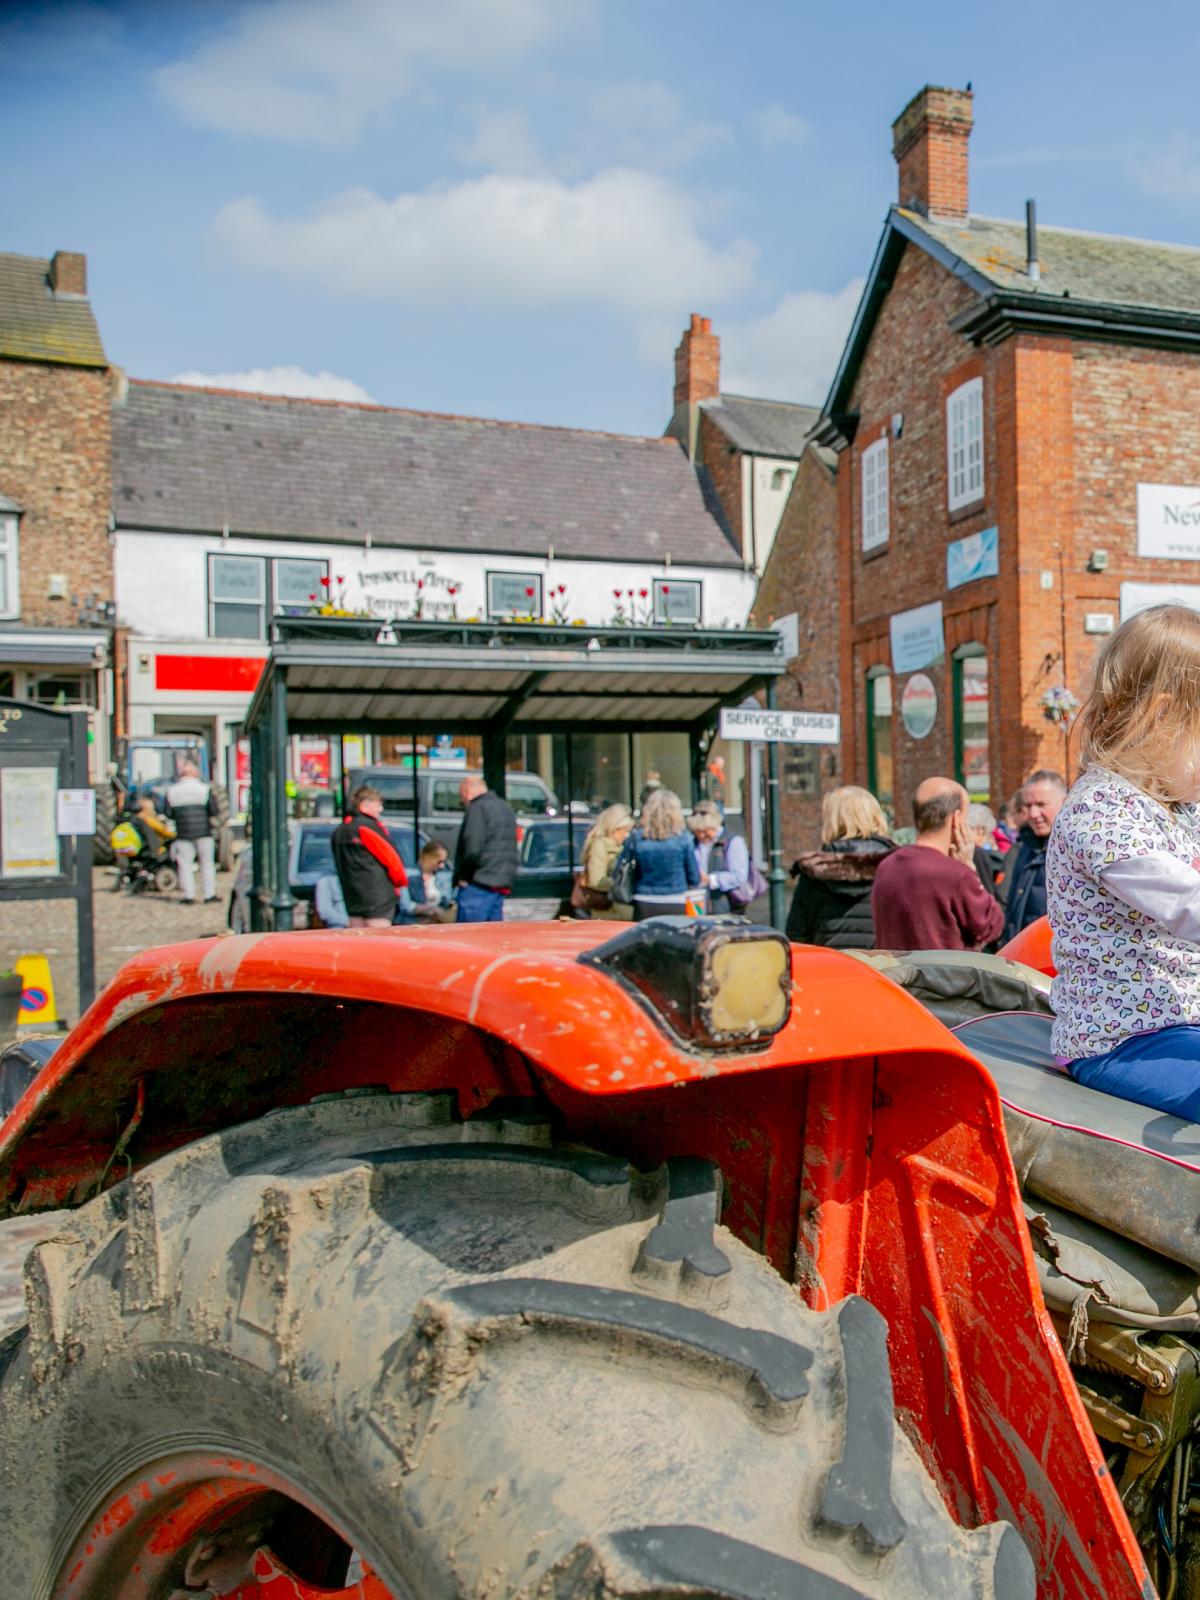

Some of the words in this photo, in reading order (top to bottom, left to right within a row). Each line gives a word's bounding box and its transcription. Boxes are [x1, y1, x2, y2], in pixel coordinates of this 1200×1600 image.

[726, 712, 783, 727] SERVICE
[792, 715, 835, 729] BUSES
[764, 727, 798, 738] ONLY
